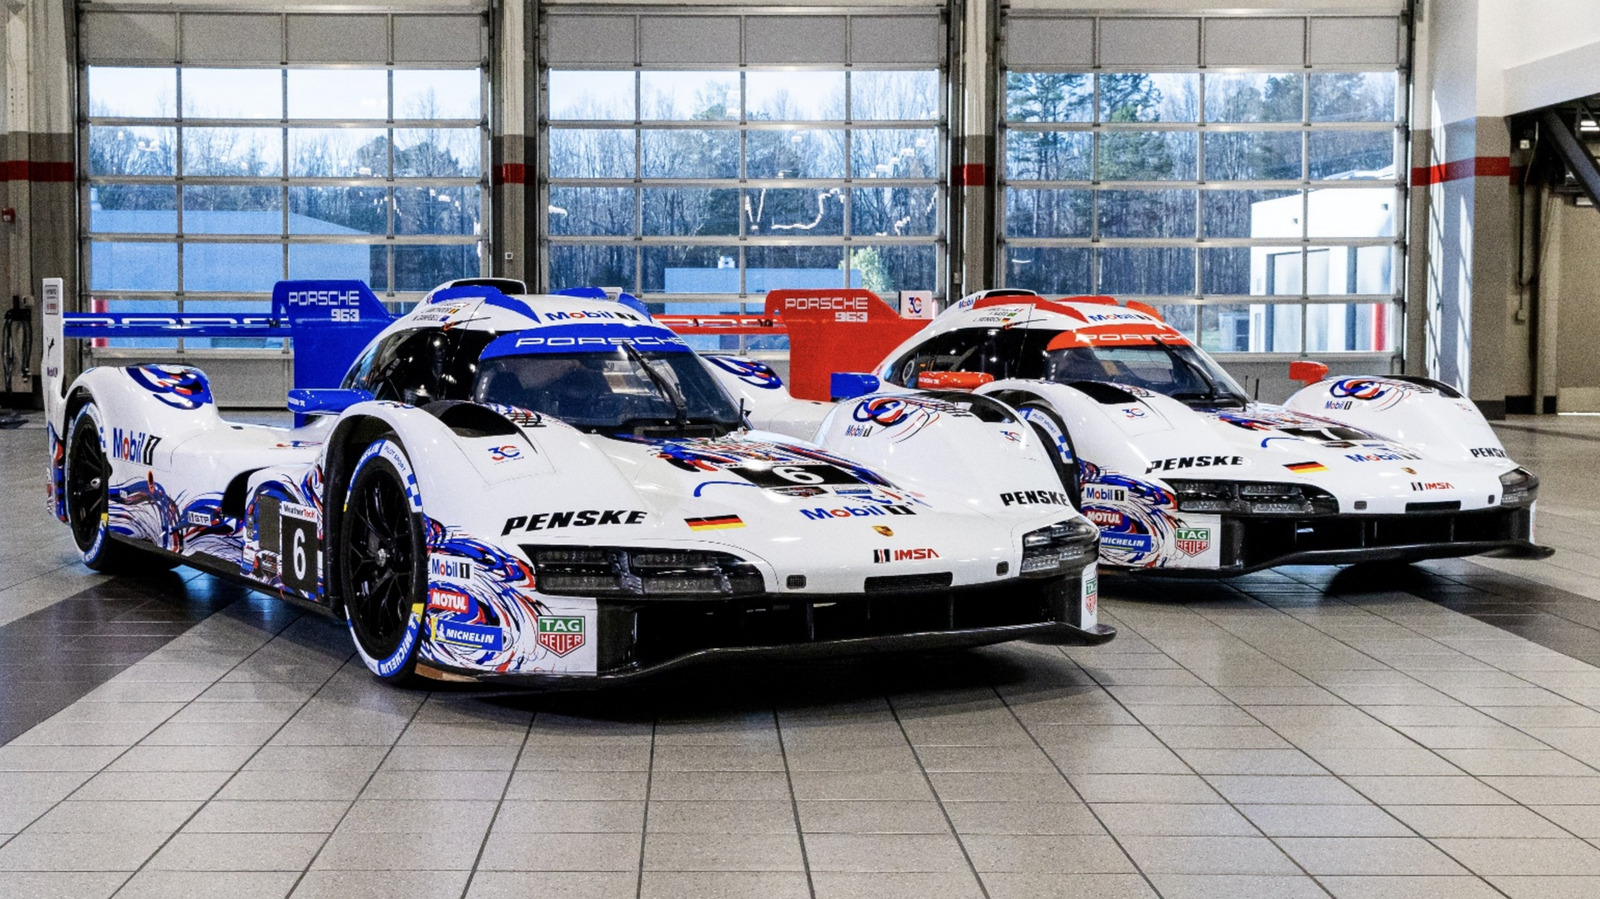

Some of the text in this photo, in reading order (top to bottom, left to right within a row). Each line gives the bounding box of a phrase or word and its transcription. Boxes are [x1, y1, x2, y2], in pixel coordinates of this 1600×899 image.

[289, 291, 359, 306] PORSCHE
[785, 297, 868, 310] PORSCHE
[331, 309, 359, 322] 963
[544, 310, 614, 321] Mobil
[834, 312, 868, 323] 963
[1088, 314, 1137, 322] Mobil
[515, 336, 686, 348] PORSCHE
[1324, 401, 1344, 410] Mobil
[845, 425, 863, 437] Mobil
[113, 427, 146, 464] Mobil
[1344, 453, 1403, 462] Mobil
[1145, 456, 1244, 475] PENSKE
[772, 466, 824, 484] 6
[1424, 482, 1455, 490] IMSA
[1000, 490, 1070, 507] PENSKE
[1086, 487, 1113, 501] Mobil
[195, 513, 210, 524] GTP
[800, 505, 886, 521] Mobil
[1086, 511, 1121, 524] MOTUL
[501, 510, 647, 536] PENSKE
[1178, 530, 1207, 539] TAG
[1101, 537, 1145, 547] MICHELIN
[1177, 540, 1208, 554] HEUER
[293, 528, 306, 580] 6
[894, 548, 940, 561] IMSA
[431, 558, 458, 578] Mobil
[431, 590, 468, 611] MOTUL
[541, 618, 582, 632] TAG
[446, 629, 495, 644] MICHELIN
[540, 632, 583, 654] HEUER
[380, 629, 414, 674] MICHELIN
